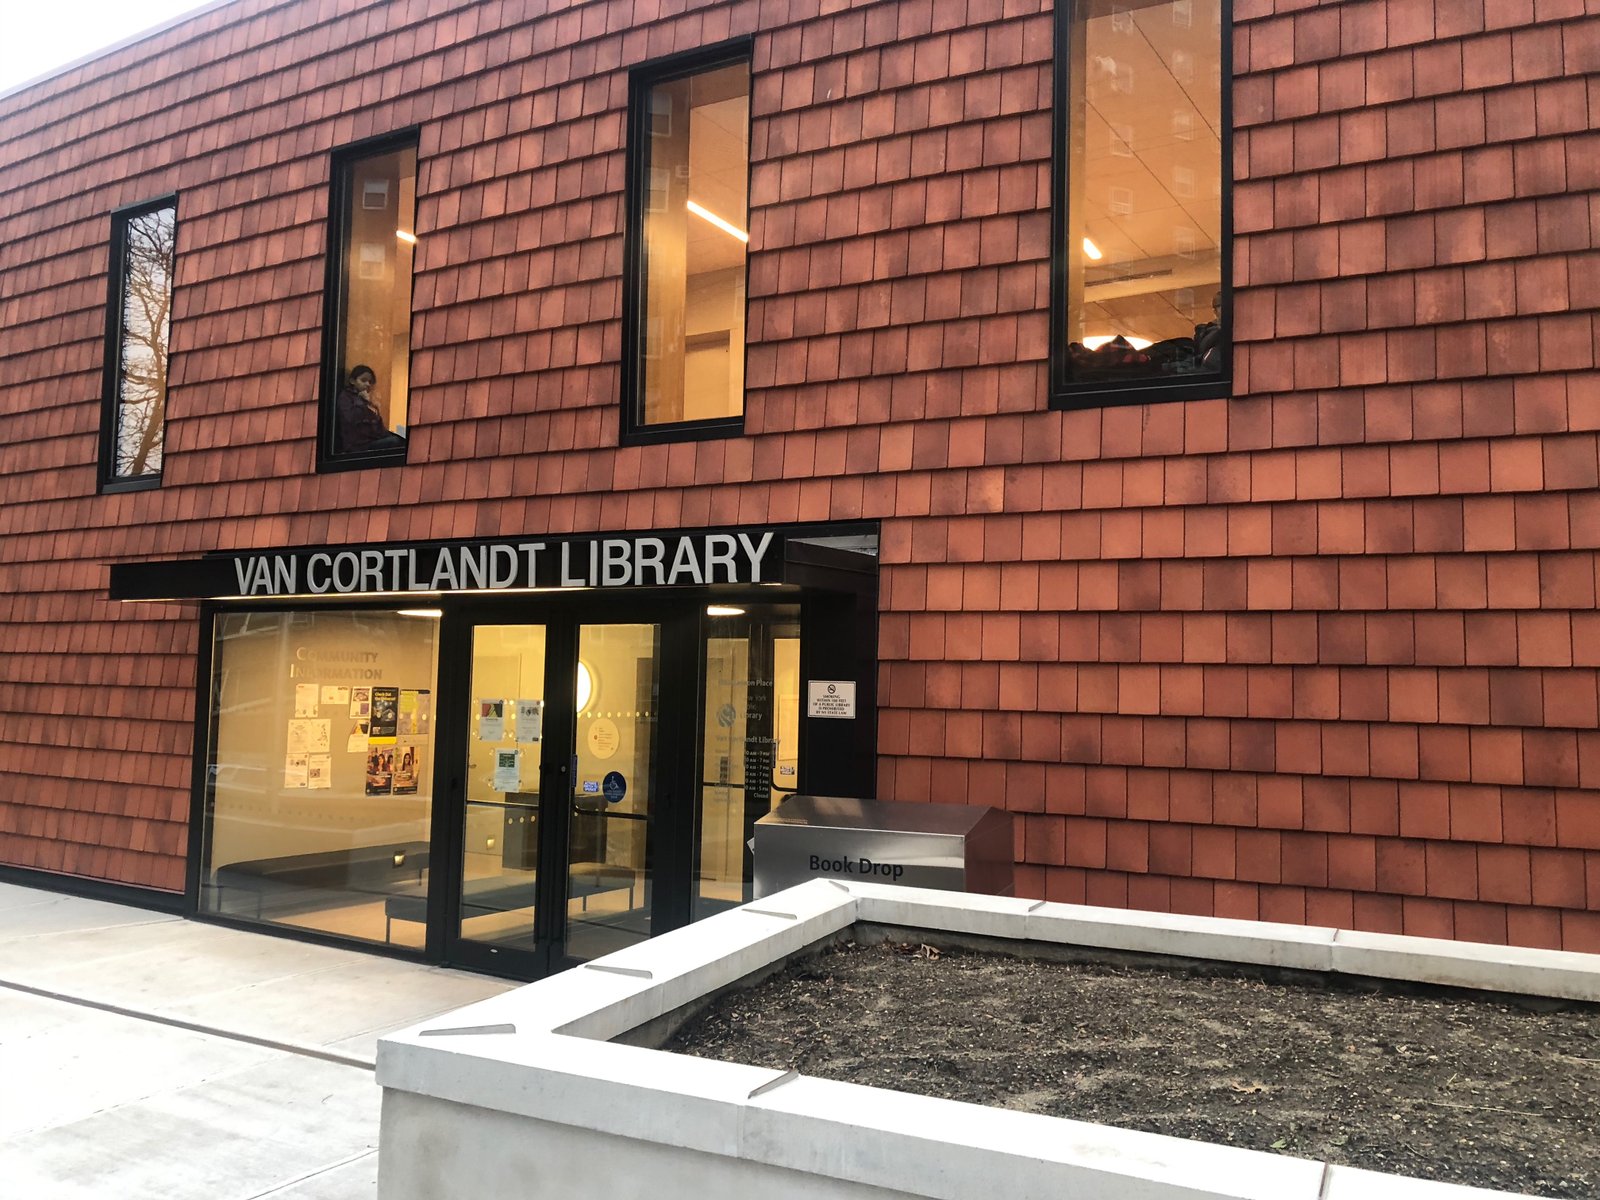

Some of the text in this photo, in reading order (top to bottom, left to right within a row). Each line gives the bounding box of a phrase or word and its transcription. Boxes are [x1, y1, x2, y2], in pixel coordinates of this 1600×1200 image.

[234, 532, 774, 596] VAN CORTLANDT LIBRARY
[809, 854, 904, 881] Book Drop
